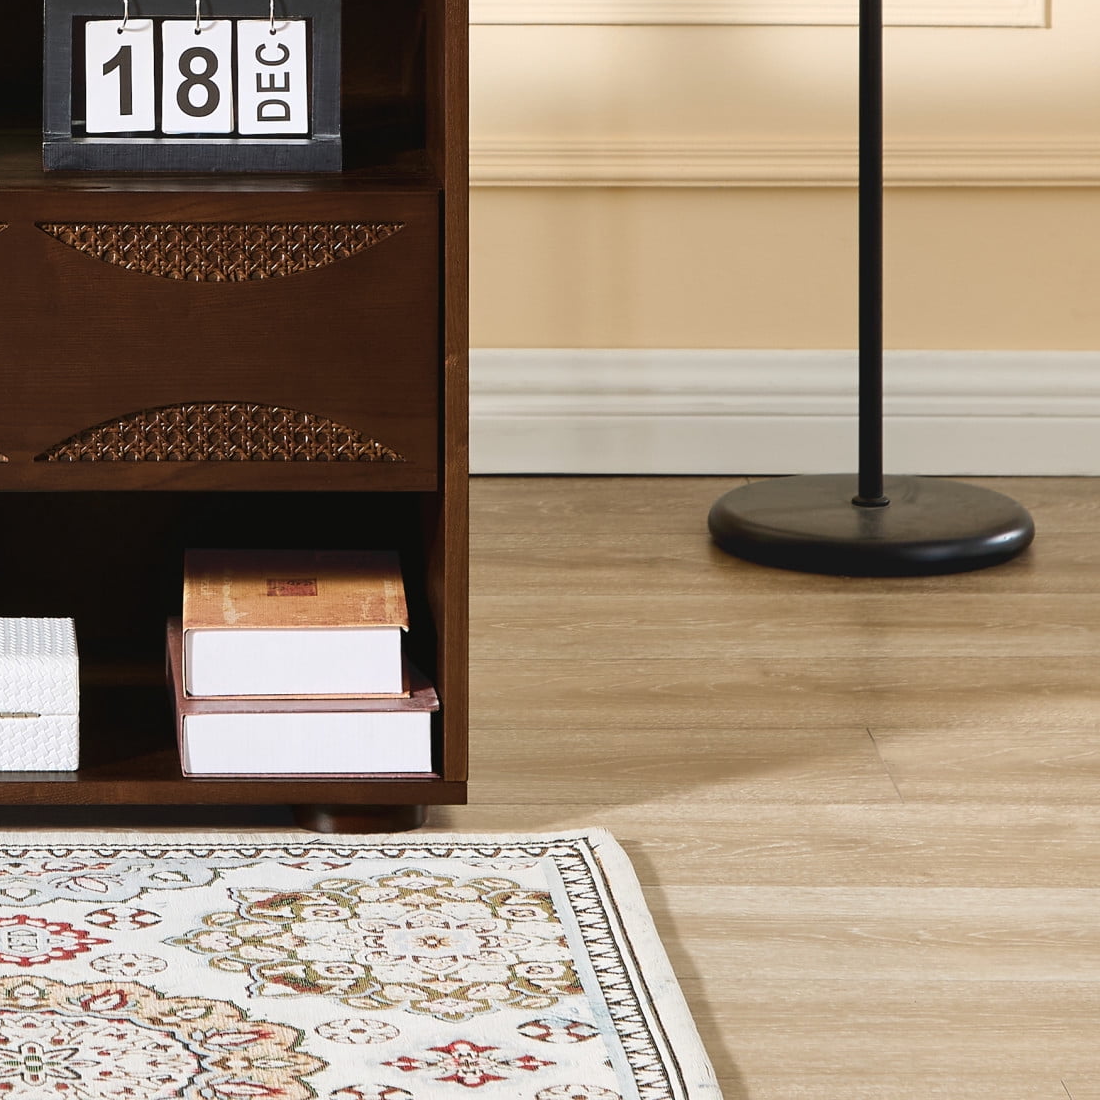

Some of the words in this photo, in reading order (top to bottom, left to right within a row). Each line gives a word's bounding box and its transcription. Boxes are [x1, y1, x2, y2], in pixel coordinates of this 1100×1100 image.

[102, 45, 133, 116] 1
[176, 46, 221, 117] 8
[255, 42, 291, 122] DEC
